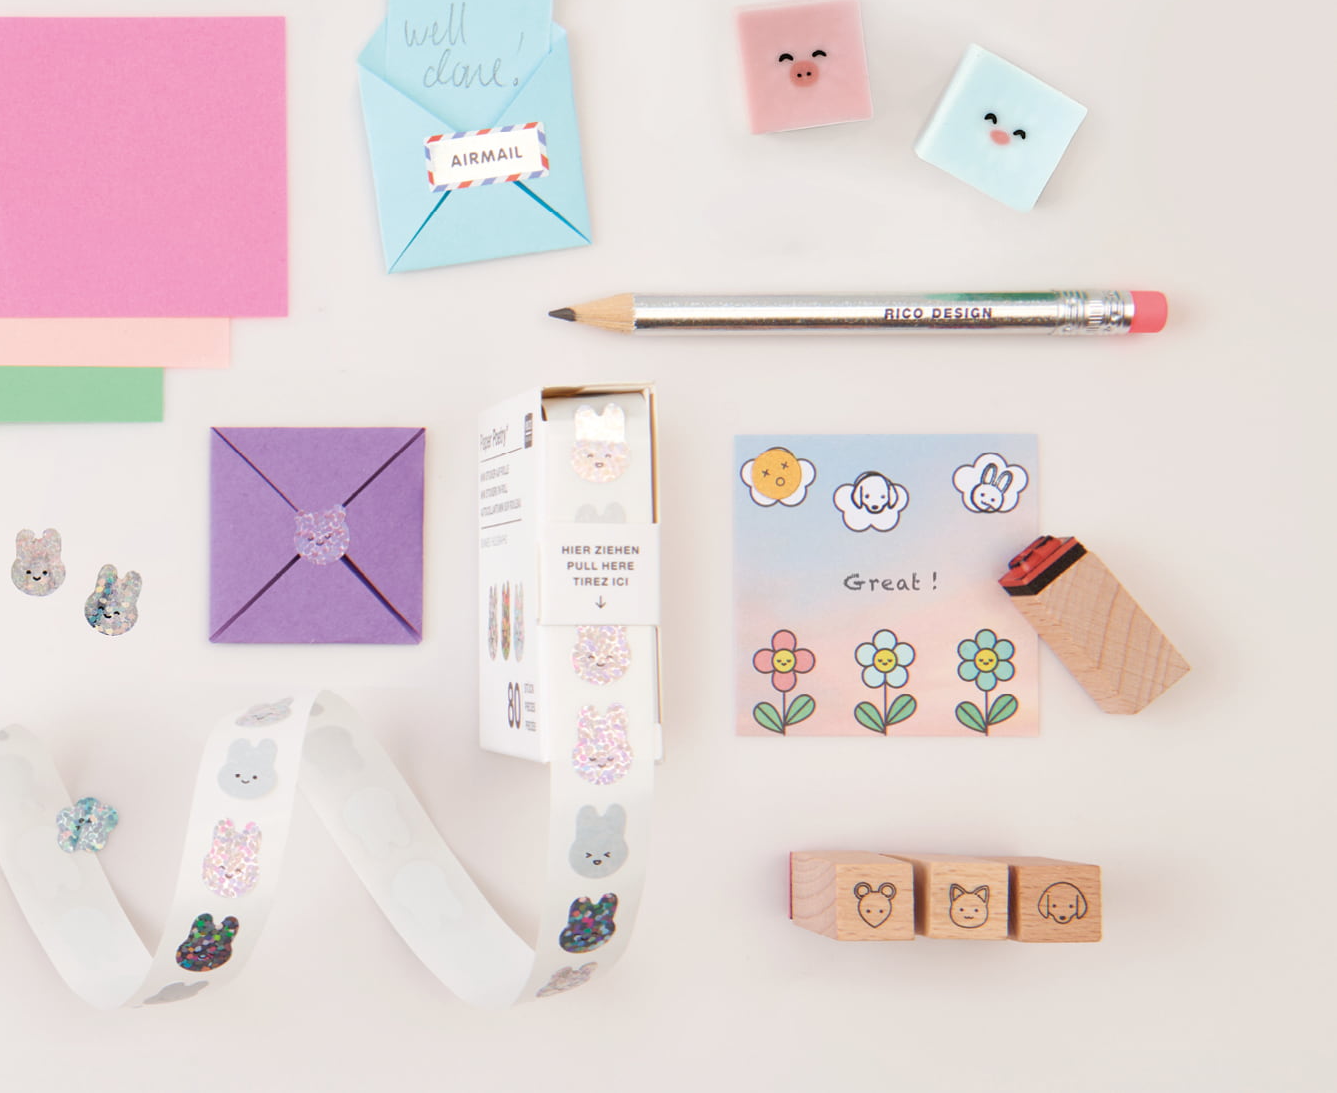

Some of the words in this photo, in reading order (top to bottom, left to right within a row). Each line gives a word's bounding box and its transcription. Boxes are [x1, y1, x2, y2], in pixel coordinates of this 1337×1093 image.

[403, 1, 467, 48] well
[450, 146, 524, 168] AIRMAIL
[884, 307, 924, 319] RICO
[931, 306, 993, 319] DESIGN
[562, 545, 591, 555] HIER
[594, 545, 640, 555] ZIEHEN
[567, 561, 598, 571] PULL
[602, 561, 635, 571] HERE
[573, 577, 609, 587] TIREZ
[612, 577, 629, 587] ICI
[843, 572, 921, 592] Great
[508, 681, 521, 729] 80
